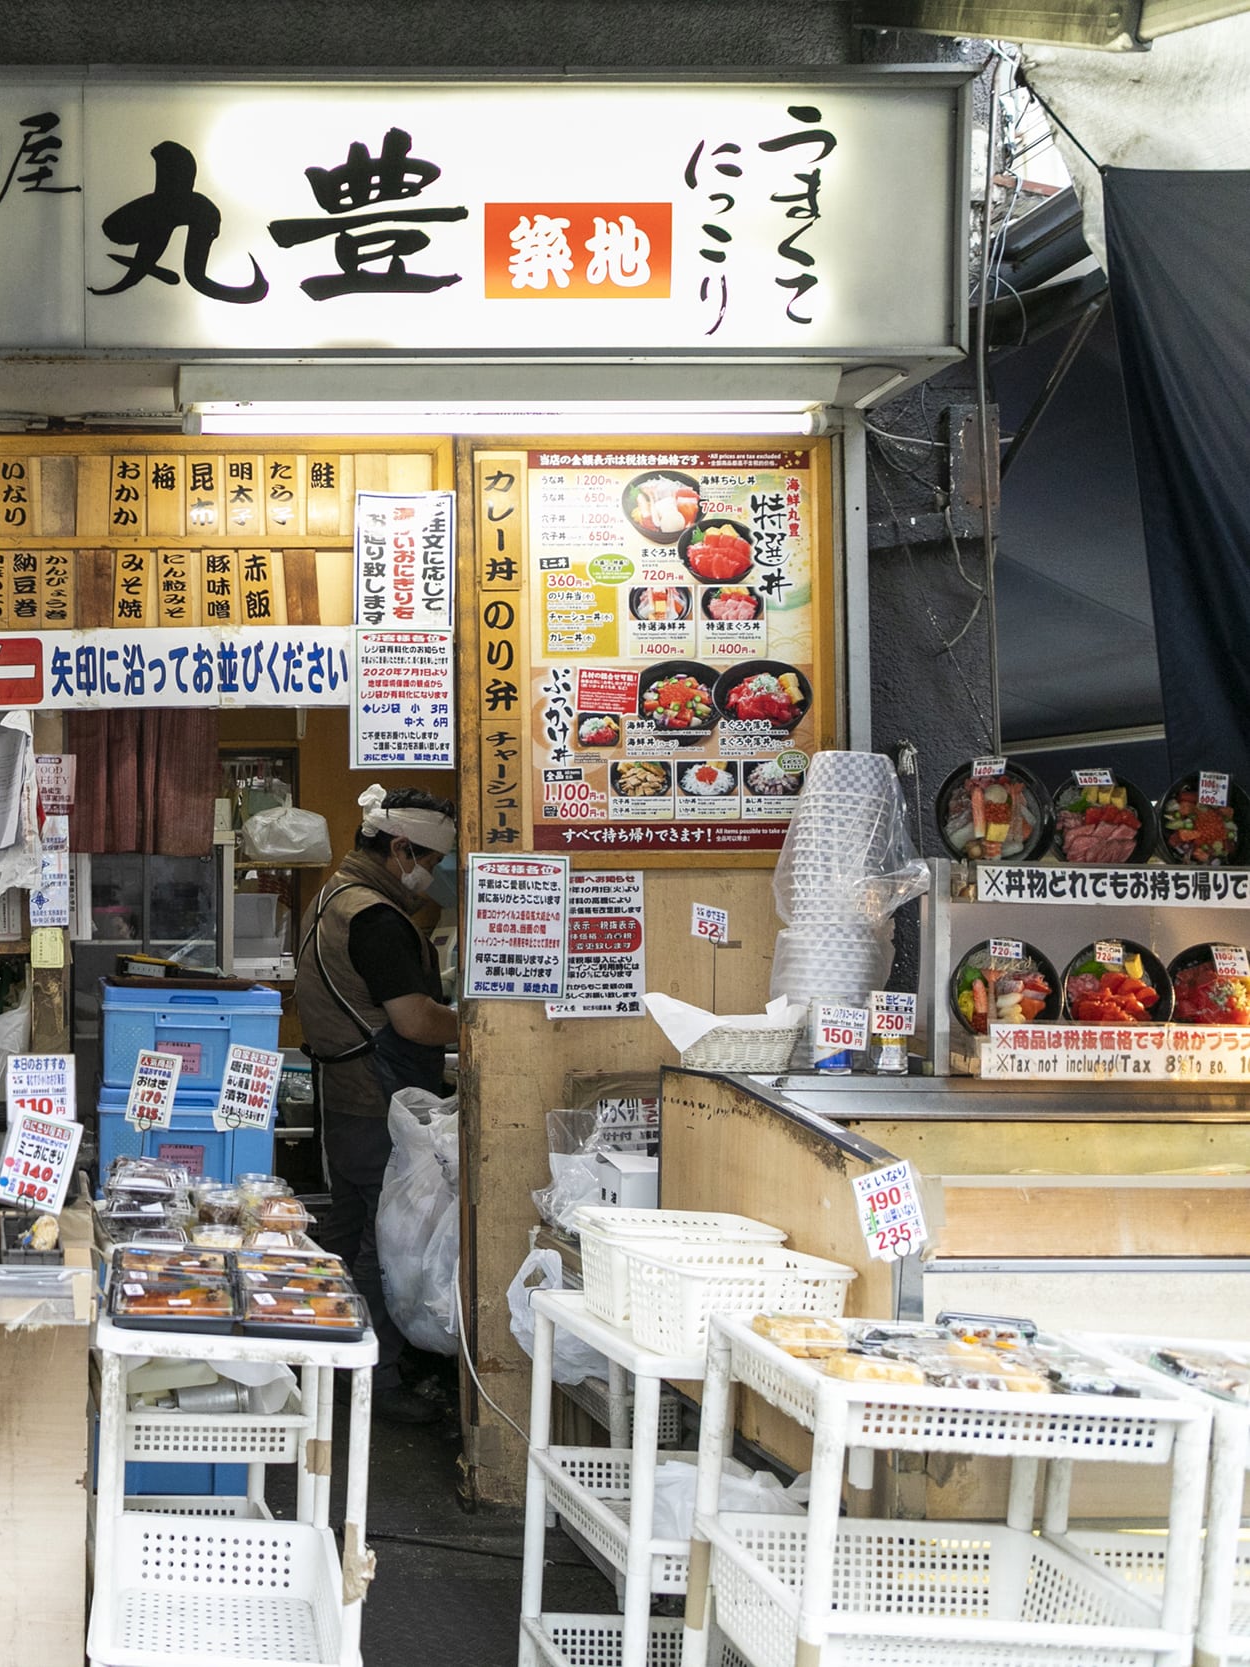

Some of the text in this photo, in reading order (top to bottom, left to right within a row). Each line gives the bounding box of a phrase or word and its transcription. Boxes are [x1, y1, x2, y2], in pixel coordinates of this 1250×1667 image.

[86, 126, 470, 305] 丸豊
[684, 138, 745, 336] にっこり
[758, 105, 839, 326] うまくて
[507, 213, 653, 292] 築地
[1, 461, 27, 527] いなり
[113, 461, 142, 527] おかか
[151, 461, 177, 491] 梅
[189, 463, 215, 528] 昆布
[229, 462, 255, 527] 明太子
[269, 461, 296, 526] たら子
[310, 462, 336, 490] 鮭
[700, 475, 756, 486] 海鮮ちらし丼
[785, 477, 801, 538] 海鮮丸豊
[483, 469, 519, 582] カレー丼
[641, 548, 677, 558] まぐろ丼
[13, 553, 39, 619] 納豆巻
[45, 554, 69, 621] かんぴょう巻
[118, 553, 144, 620] みそ焼
[206, 554, 232, 620] 豚味噌
[244, 553, 273, 620] 赤飯
[393, 507, 416, 620] 温いおにぎりを
[540, 557, 570, 570] ミニ丼
[483, 600, 519, 712] のり弁
[637, 621, 687, 632] 特選海鮮丼
[706, 621, 761, 632] 特選まぐろ丼
[50, 640, 349, 698] 矢印に沿ってお並びください
[543, 668, 575, 768] ぶっかけ丼
[485, 731, 520, 844] チャーシュー丼
[562, 827, 712, 844] すべて持ち帰りできます!
[12, 1058, 67, 1071] 本日のおすすめ
[136, 1076, 170, 1091] おはぎ
[1038, 1057, 1059, 1071] not
[873, 1164, 908, 1188] いなり
